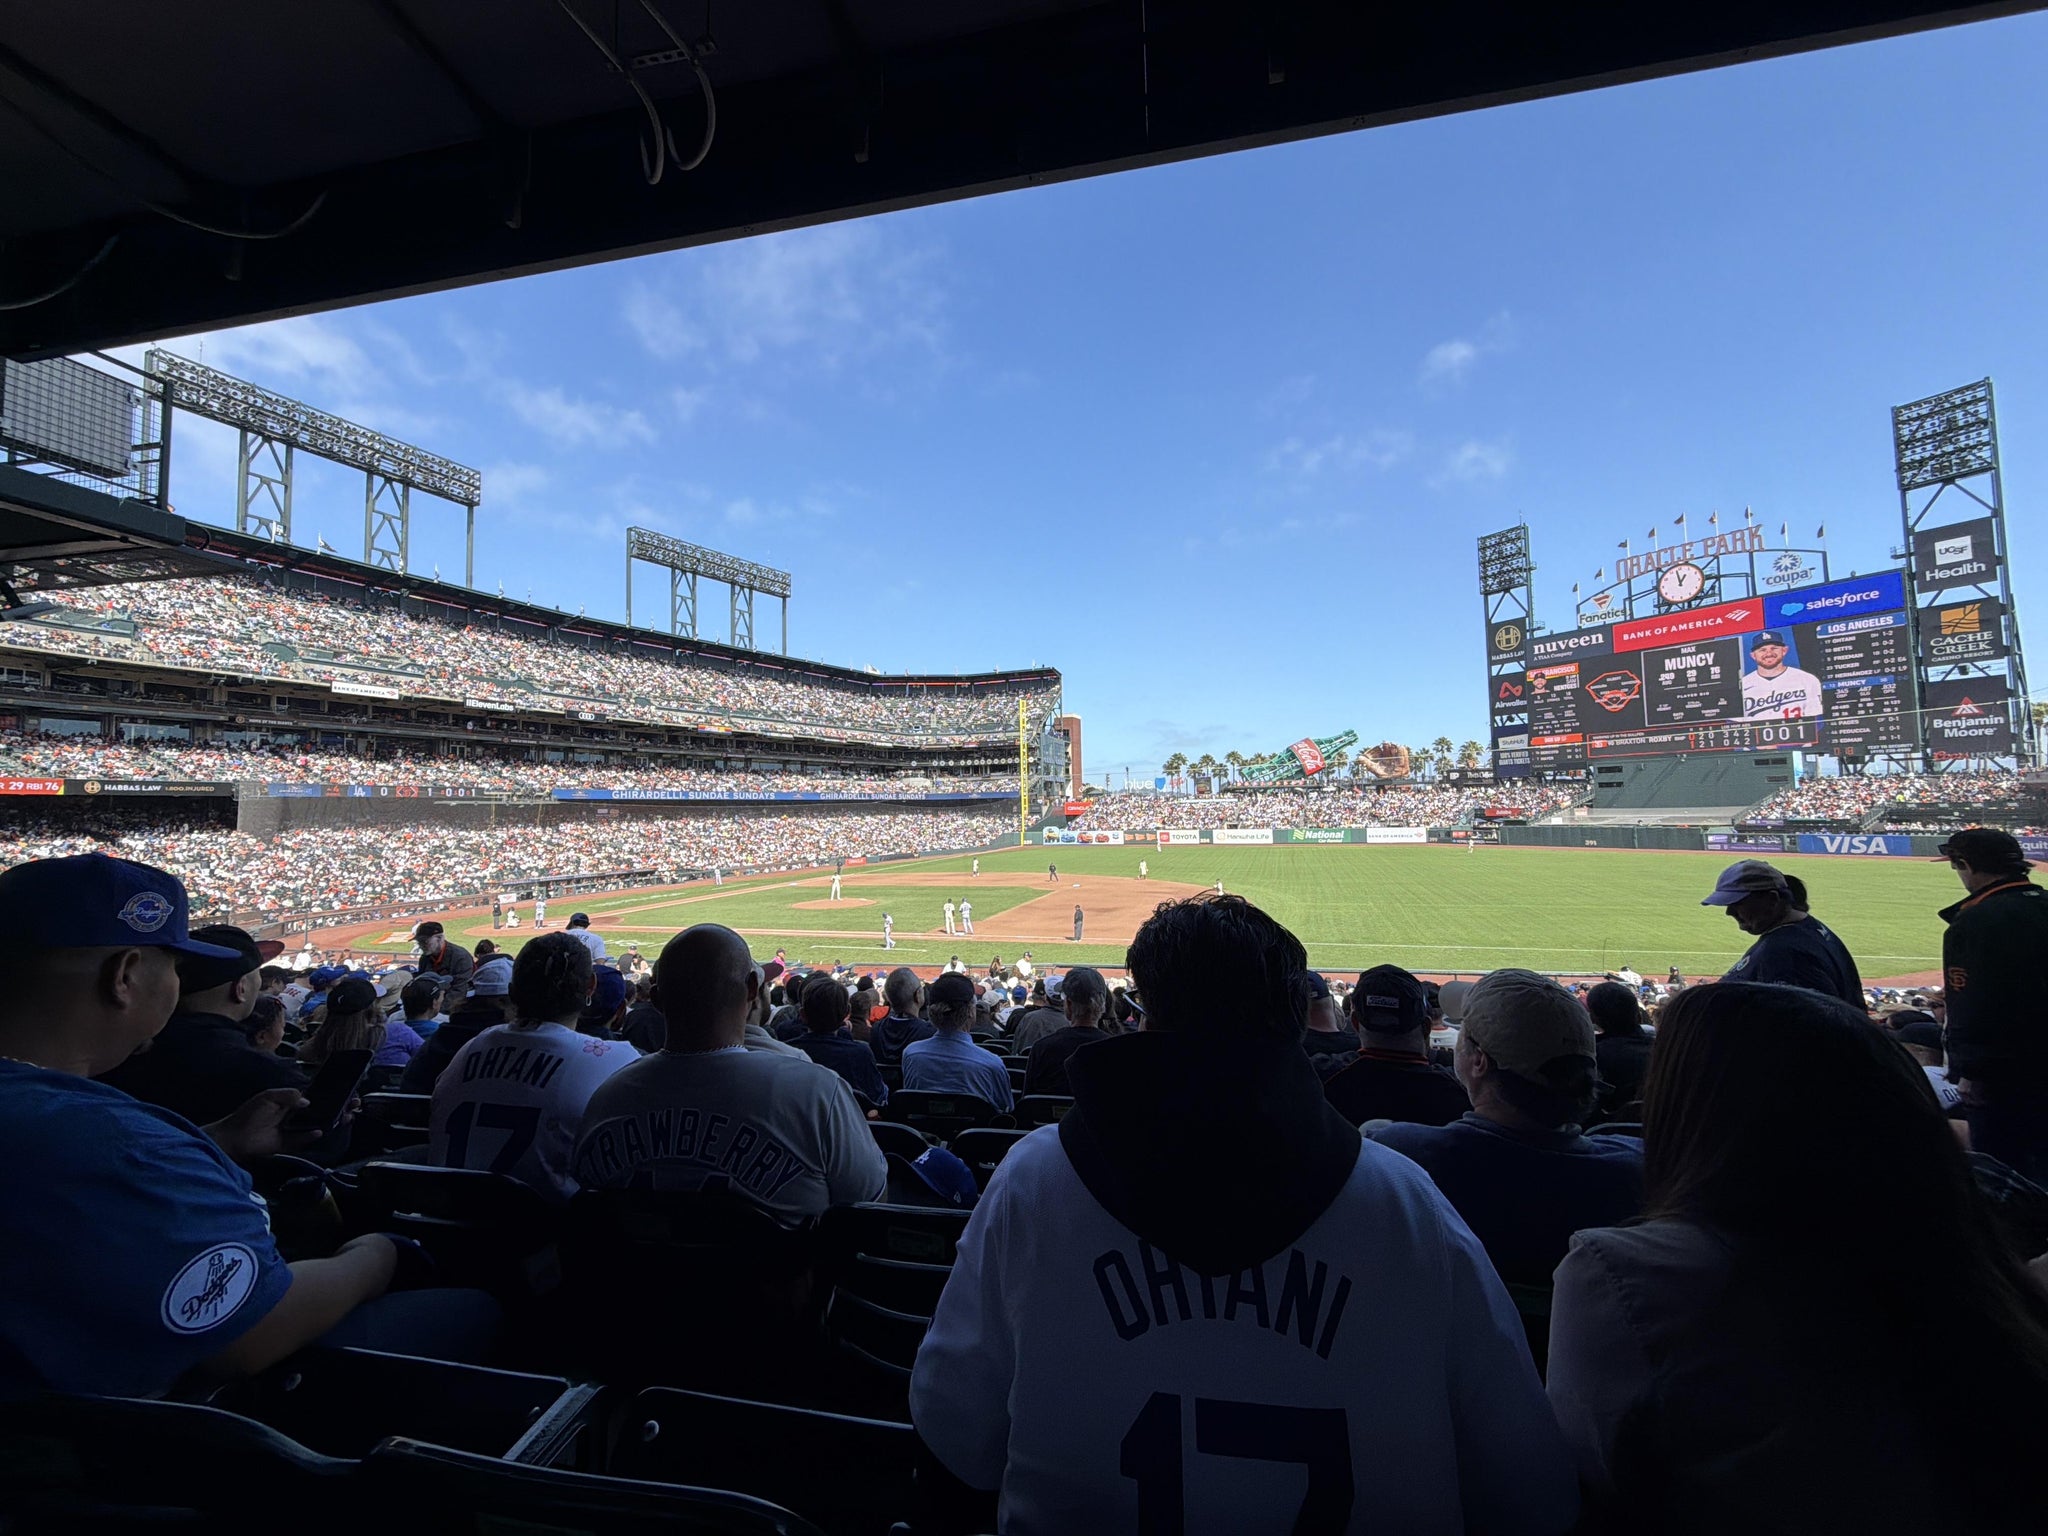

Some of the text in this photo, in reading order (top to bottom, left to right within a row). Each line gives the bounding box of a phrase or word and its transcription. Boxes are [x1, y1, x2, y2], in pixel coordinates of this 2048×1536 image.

[1616, 524, 1764, 583] ORACLE PARK
[1939, 545, 1968, 555] UCSF
[1766, 570, 1809, 586] coupa
[1925, 562, 1986, 581] Health
[1806, 590, 1880, 610] salesforce
[1580, 608, 1626, 625] Fanatics
[1623, 617, 1723, 641] BANK OF AMERICA
[1828, 616, 1893, 633] LOS ANGELES
[1533, 633, 1604, 655] nuveen
[1832, 636, 1856, 644] OHTANI
[1930, 631, 1994, 647] CACHE
[1681, 646, 1696, 654] MAX
[1932, 641, 1993, 655] CREEK
[1664, 652, 1715, 672] MUNCY
[1833, 653, 1864, 661] FREEMAN
[1931, 650, 1995, 662] CASINO RESORT
[1834, 662, 1860, 670] TUCKER
[1837, 679, 1866, 687] MUNCY
[1495, 699, 1528, 709] Airwallex
[1744, 689, 1807, 712] Dodgers
[1933, 715, 2004, 729] Benjamin
[1649, 735, 1672, 743] ROXBY
[1688, 732, 1696, 741] 0
[1763, 725, 1804, 741] 0 0 1
[1944, 727, 1994, 738] Moore
[9, 781, 59, 791] 29 RBI 76
[1124, 778, 1153, 790] blue
[380, 786, 388, 797] 0
[427, 787, 433, 797] 1
[445, 787, 452, 797] 0
[458, 787, 465, 797] 0
[471, 788, 476, 797] 1
[688, 791, 730, 800] SUNDAE
[732, 792, 776, 800] SUNDAYS
[1305, 830, 1345, 839] National
[1818, 836, 1888, 854] VISA
[463, 1046, 564, 1090] OHTANI
[445, 1101, 542, 1172] 17
[182, 1258, 242, 1321] Dodgers
[1119, 1391, 1354, 1536] 17
